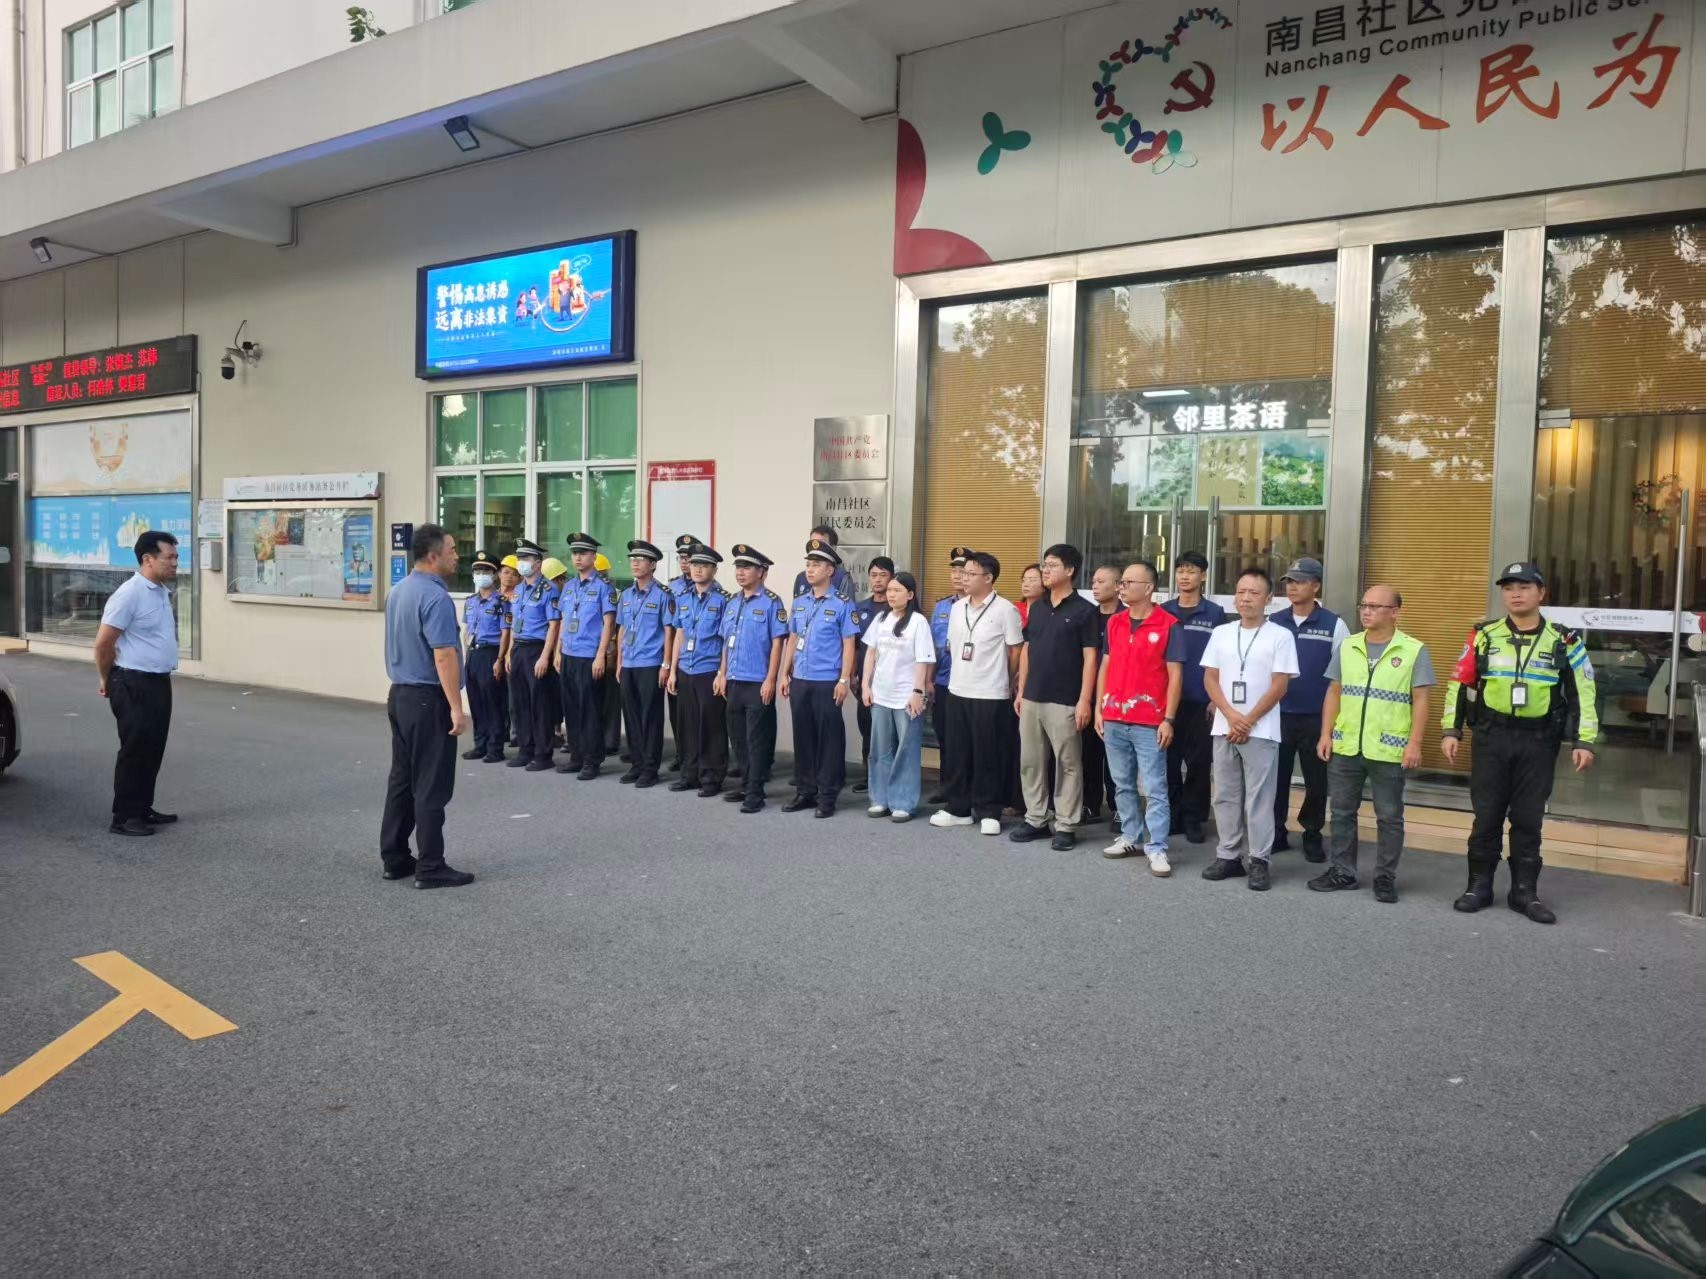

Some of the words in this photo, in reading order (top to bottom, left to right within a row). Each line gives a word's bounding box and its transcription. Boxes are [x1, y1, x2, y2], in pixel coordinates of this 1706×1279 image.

[1265, 0, 1526, 56] 南昌社区
[1265, 46, 1371, 78] Nanchang
[1379, 17, 1510, 56] Community
[1519, 1, 1598, 29] Public
[1260, 13, 1681, 154] 以人民为
[1172, 400, 1288, 432] 邻里茶语
[820, 515, 877, 530] 居民委员会
[825, 496, 872, 511] 南昌社区
